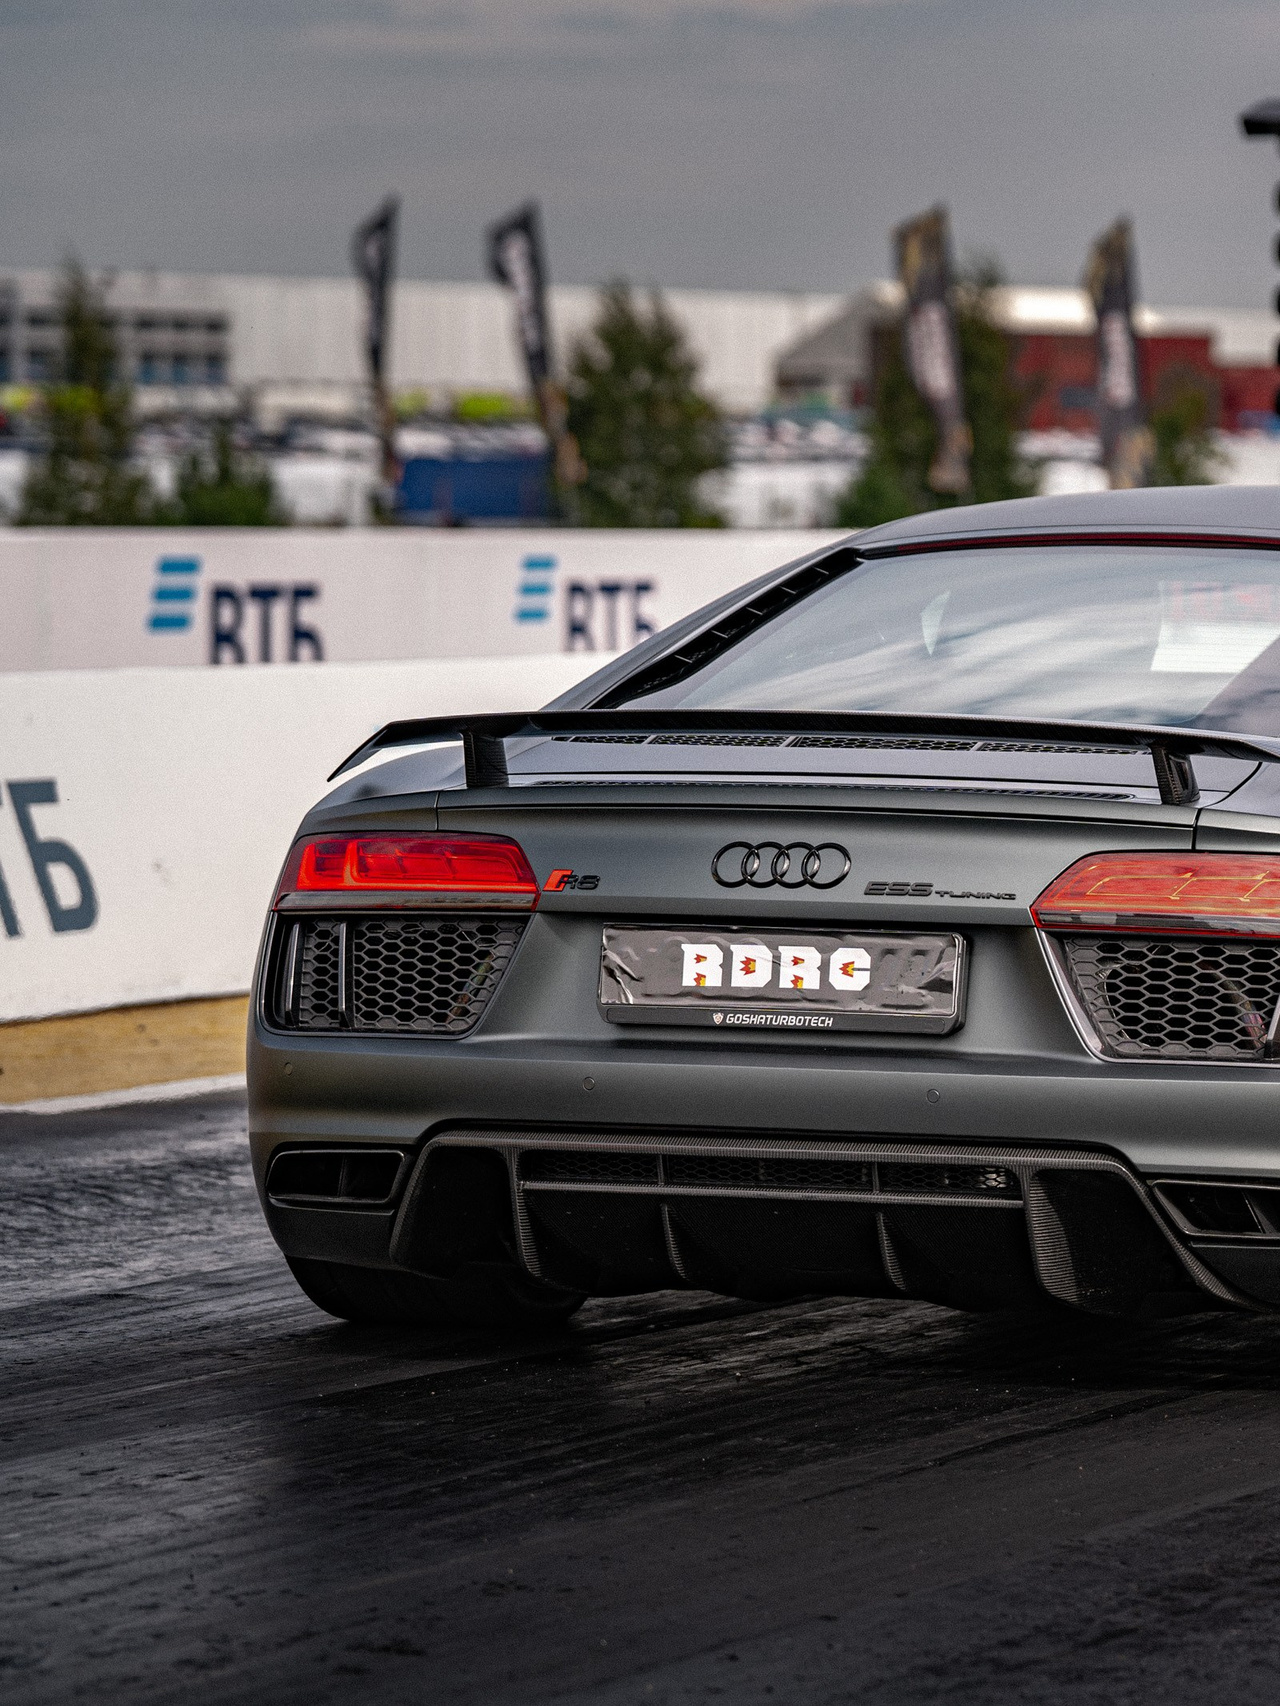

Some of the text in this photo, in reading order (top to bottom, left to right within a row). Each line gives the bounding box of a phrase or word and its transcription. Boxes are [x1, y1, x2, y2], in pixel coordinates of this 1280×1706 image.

[550, 870, 600, 891] R8
[863, 880, 1017, 901] ESS TUNING
[681, 943, 872, 991] RDRC
[725, 1012, 834, 1027] GOSHATURBOTECH
